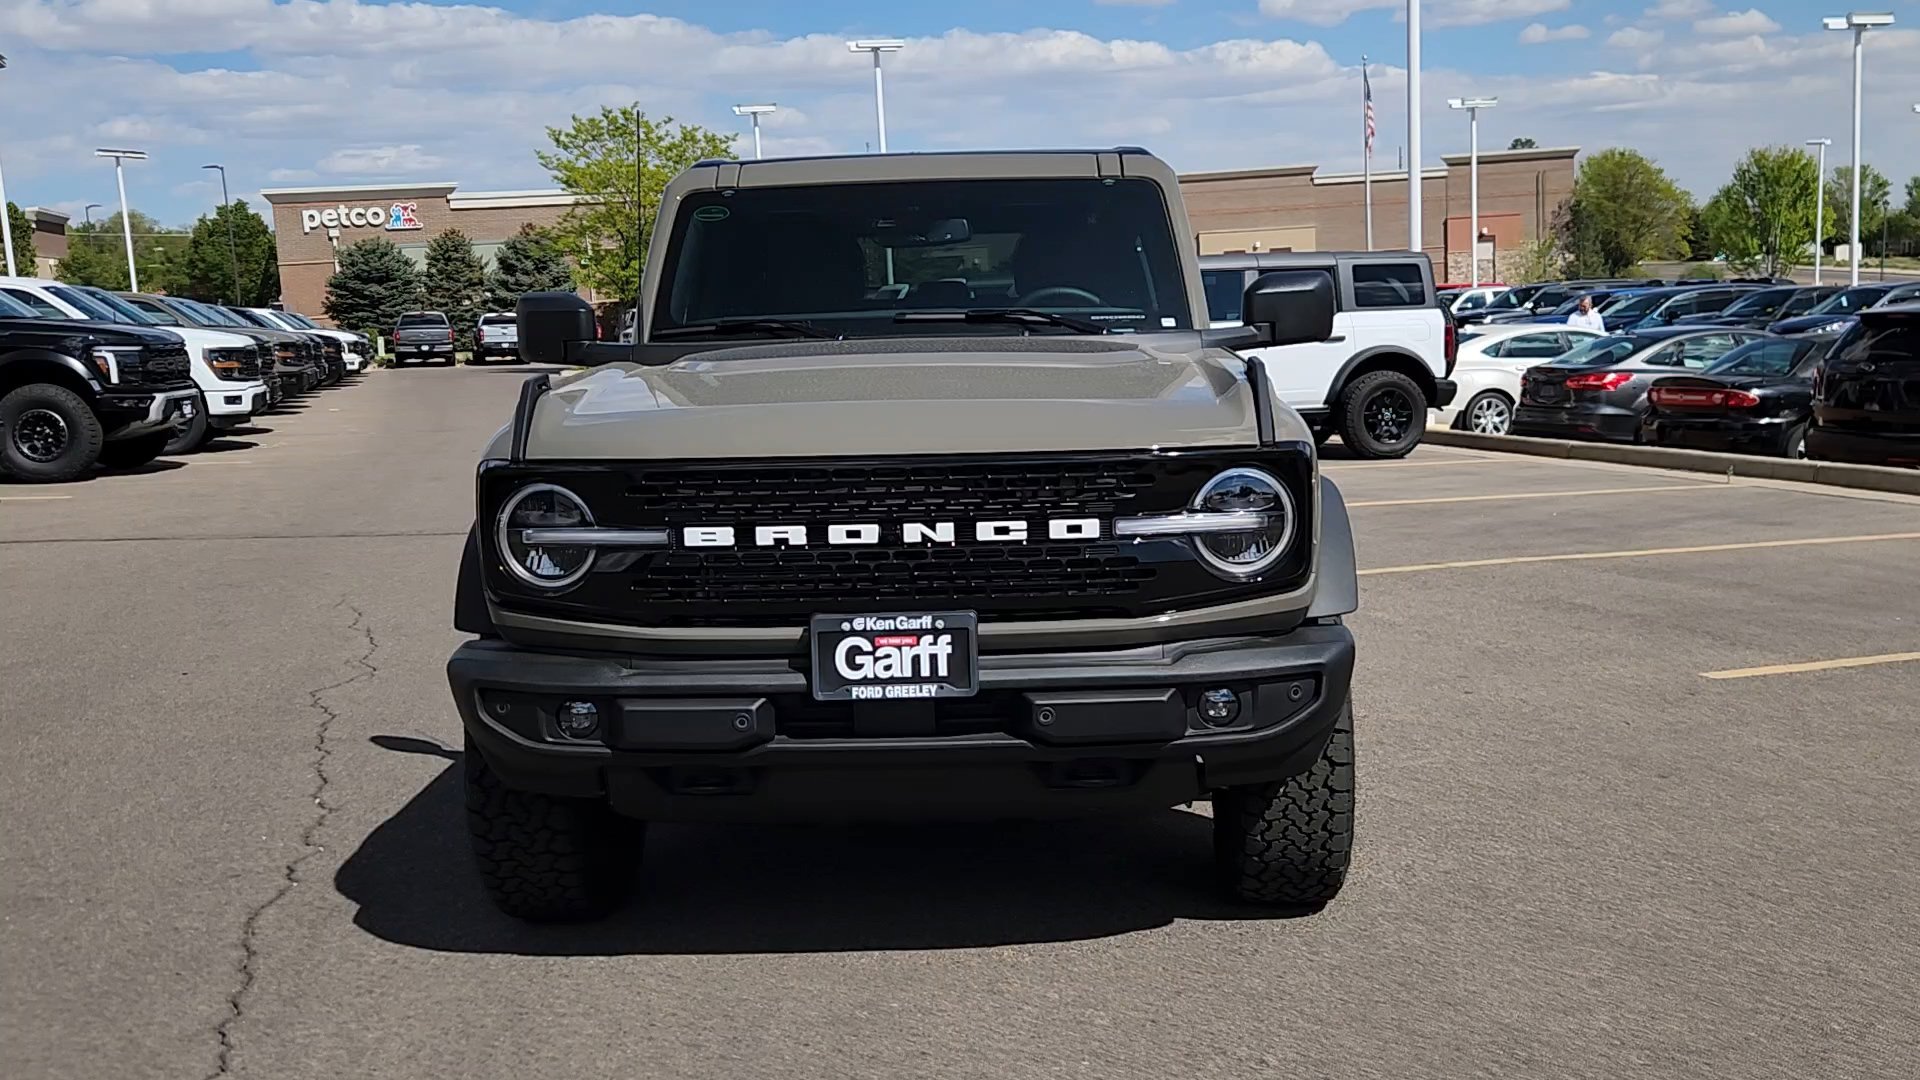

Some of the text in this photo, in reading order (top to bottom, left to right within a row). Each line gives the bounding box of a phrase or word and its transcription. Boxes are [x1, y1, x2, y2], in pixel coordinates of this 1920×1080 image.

[302, 204, 386, 234] petco
[683, 518, 1100, 547] BRONCO
[866, 615, 932, 630] Ken Garff
[835, 634, 953, 680] Garff
[851, 684, 938, 699] FORD GREELEY
